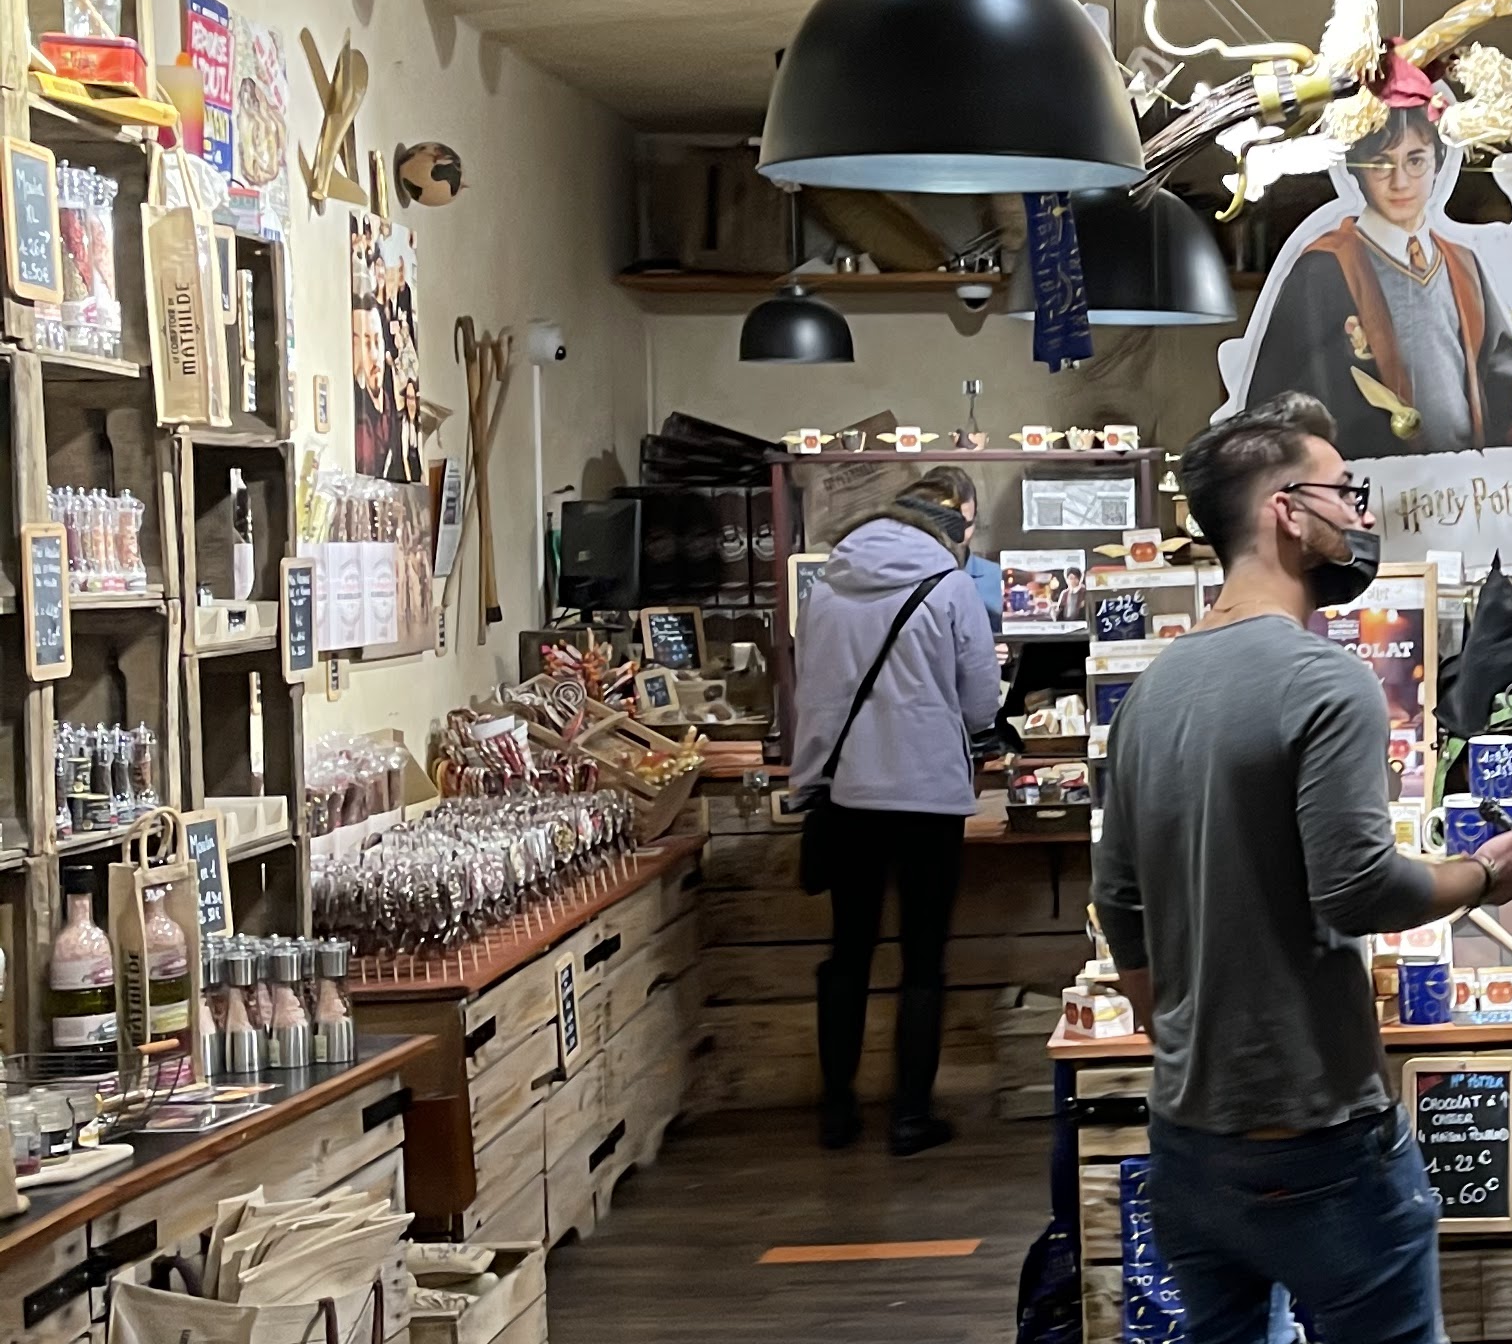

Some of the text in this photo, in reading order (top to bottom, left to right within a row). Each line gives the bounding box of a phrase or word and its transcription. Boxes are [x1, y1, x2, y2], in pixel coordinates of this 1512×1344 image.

[174, 282, 197, 376] MATHILDE
[1396, 486, 1469, 535] Harry
[1419, 1094, 1483, 1112] CHOCOLAT
